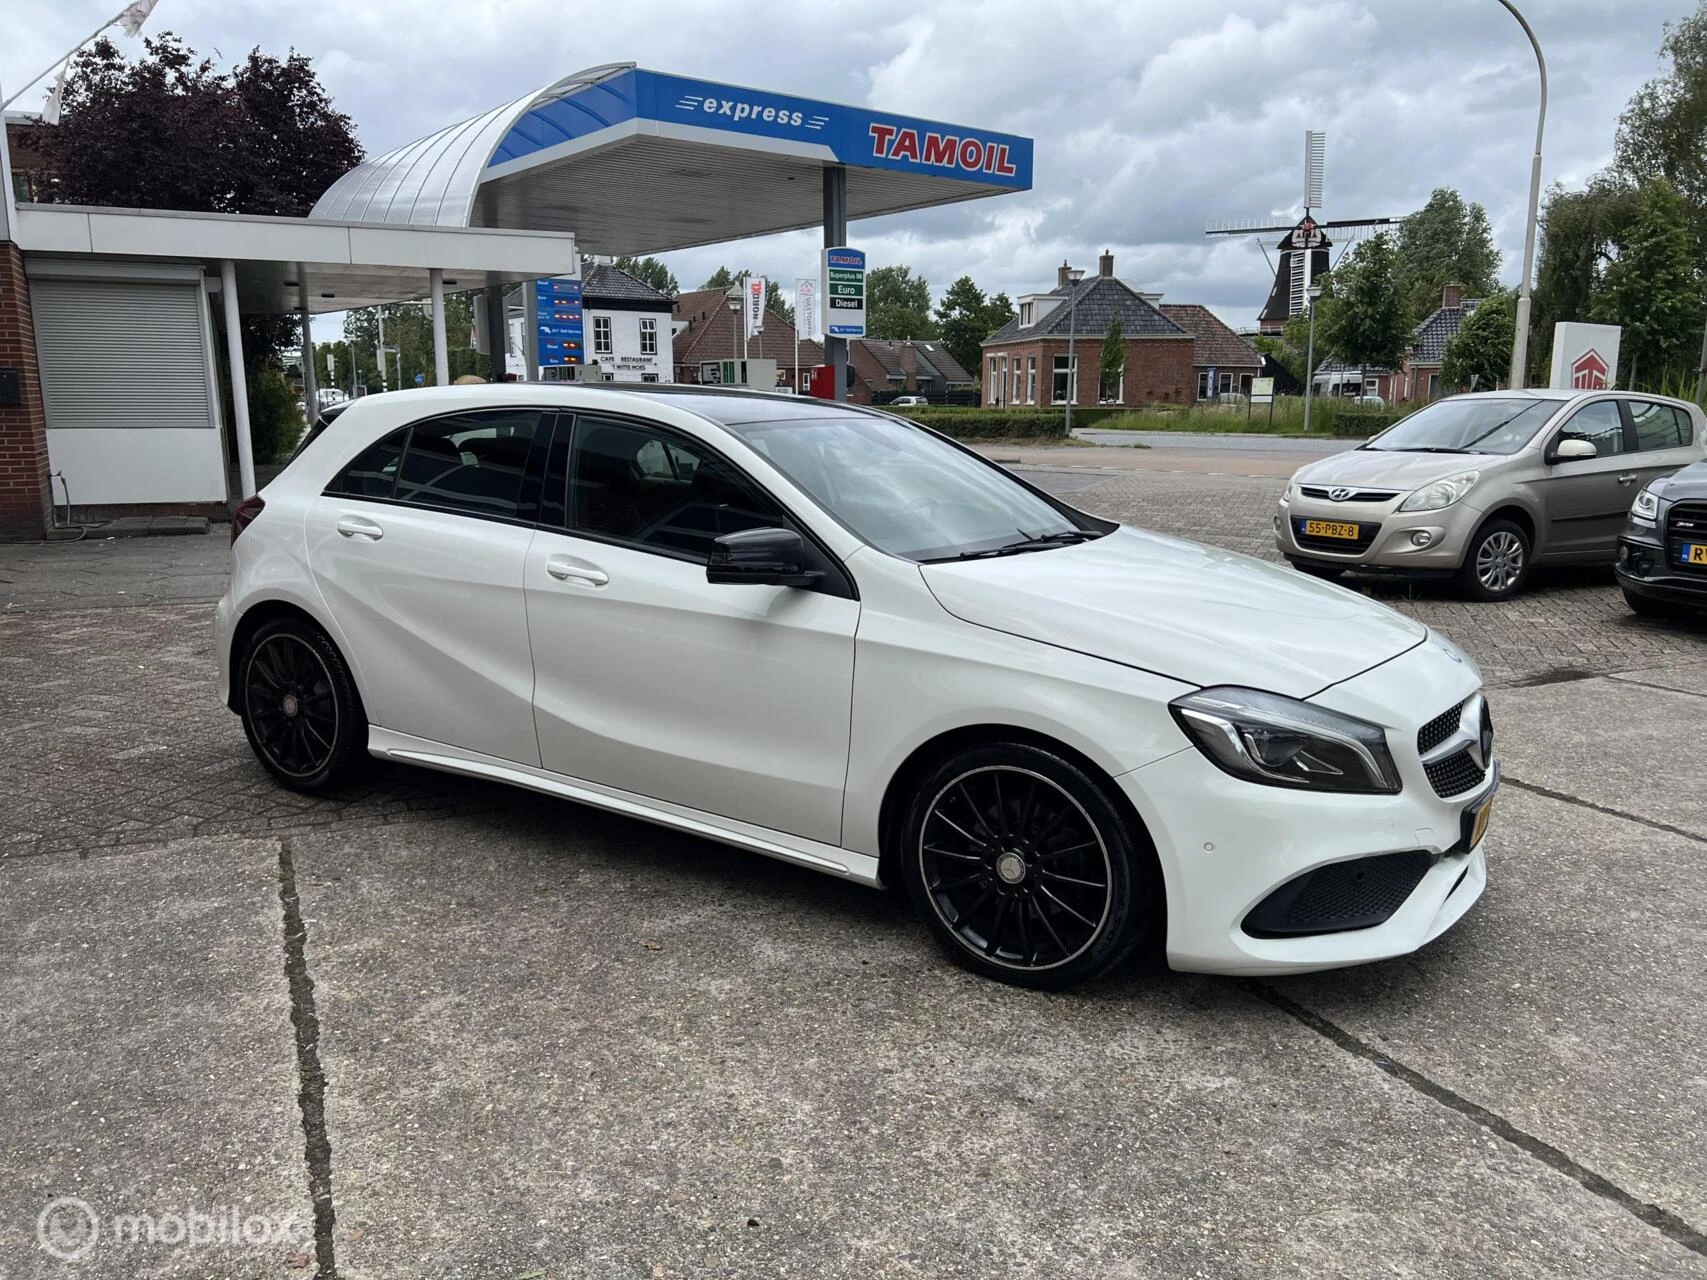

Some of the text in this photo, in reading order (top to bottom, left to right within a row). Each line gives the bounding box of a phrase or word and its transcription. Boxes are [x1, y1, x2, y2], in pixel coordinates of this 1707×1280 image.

[703, 96, 803, 127] express
[868, 122, 1016, 177] TAMOIL
[830, 255, 863, 265] TAMOIL
[830, 271, 855, 280] Superplus
[838, 285, 855, 294] Euro
[835, 299, 858, 308] Diesel
[1309, 522, 1354, 537] 55-PBZ-8
[1694, 547, 1707, 561] R
